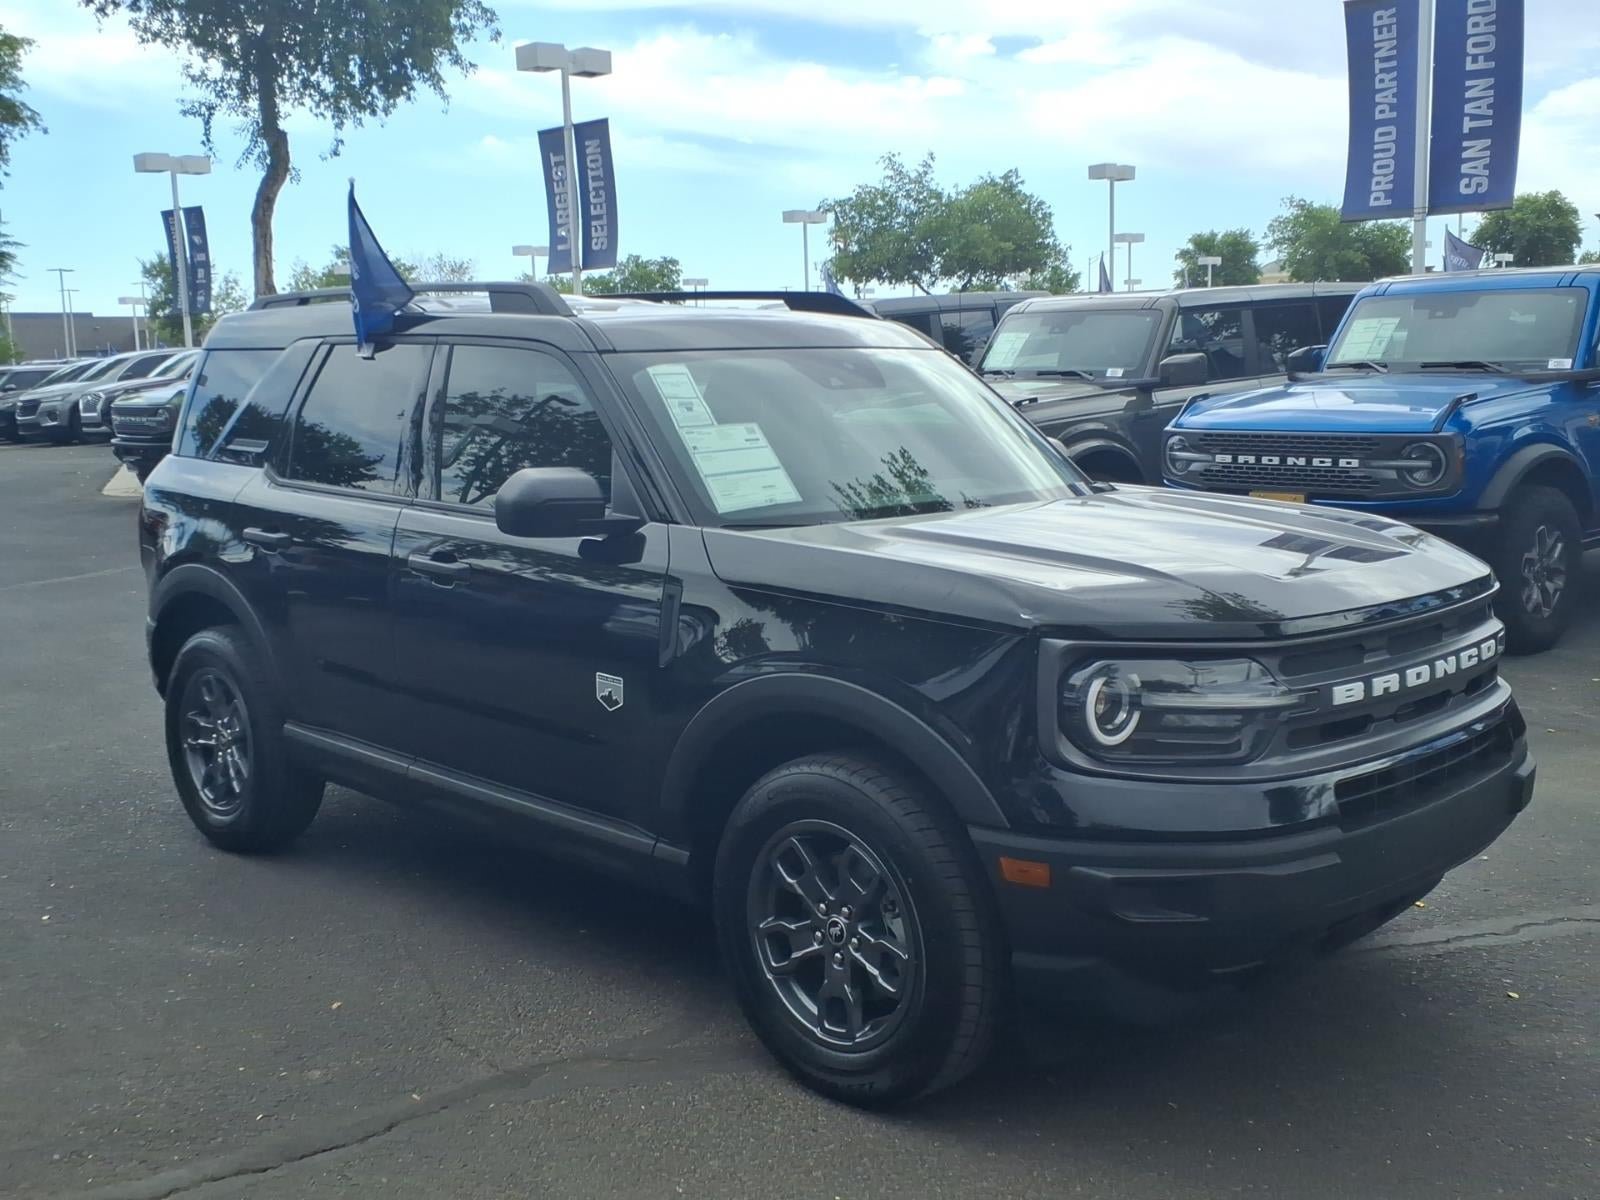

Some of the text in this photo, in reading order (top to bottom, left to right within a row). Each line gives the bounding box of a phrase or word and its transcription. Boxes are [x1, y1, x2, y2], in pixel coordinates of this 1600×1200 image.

[1369, 7, 1397, 207] PROUD PARTNER
[1459, 0, 1497, 195] SAN TAN FORD
[550, 152, 572, 251] LARGEST
[585, 139, 608, 251] SELECTION
[1215, 454, 1360, 468] BRONCO
[1332, 639, 1496, 706] BRONCO
